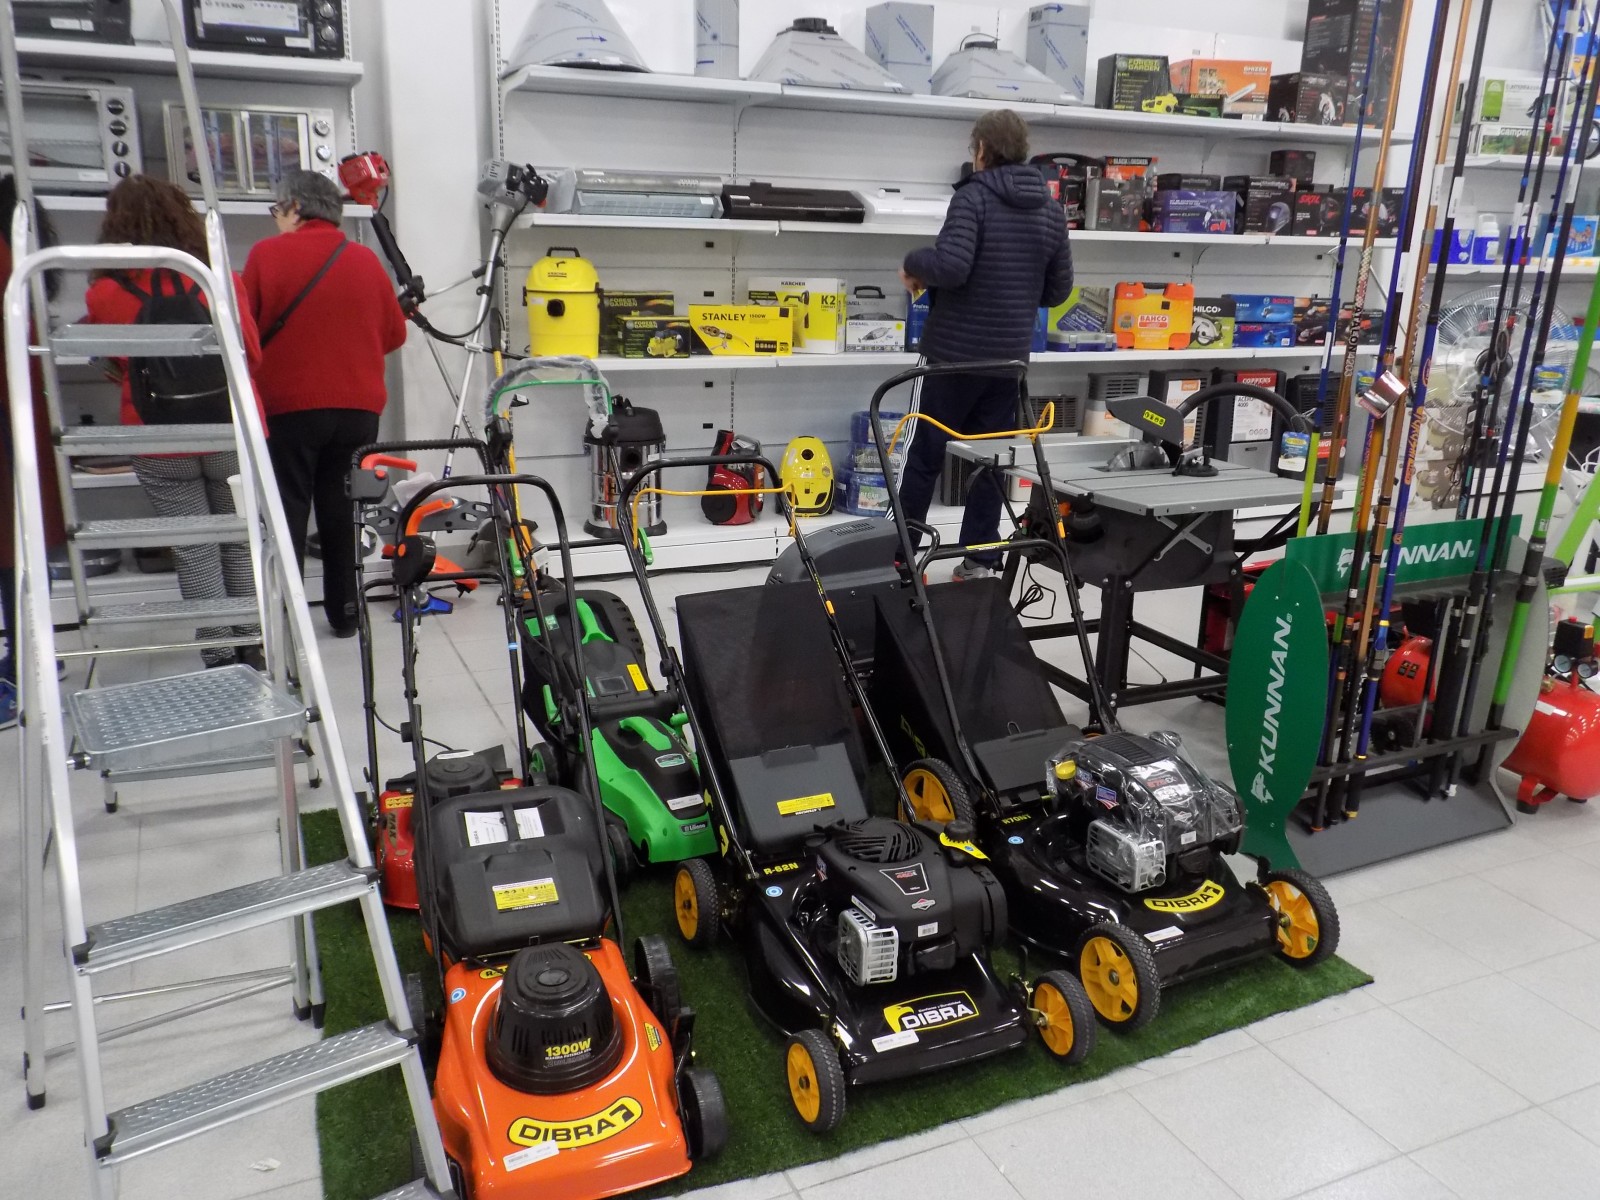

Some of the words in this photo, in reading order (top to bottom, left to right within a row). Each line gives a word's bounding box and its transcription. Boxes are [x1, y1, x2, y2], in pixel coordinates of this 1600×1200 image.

[1500, 128, 1530, 137] camper
[821, 295, 836, 305] K2
[702, 312, 746, 321] STANLEY
[1257, 616, 1293, 775] KUNNAN
[763, 862, 799, 875] R-62N
[1151, 893, 1213, 908] DIBRA
[901, 1004, 974, 1029] DIBRA
[545, 1037, 591, 1057] 1300W
[519, 1118, 616, 1142] DIBRA
